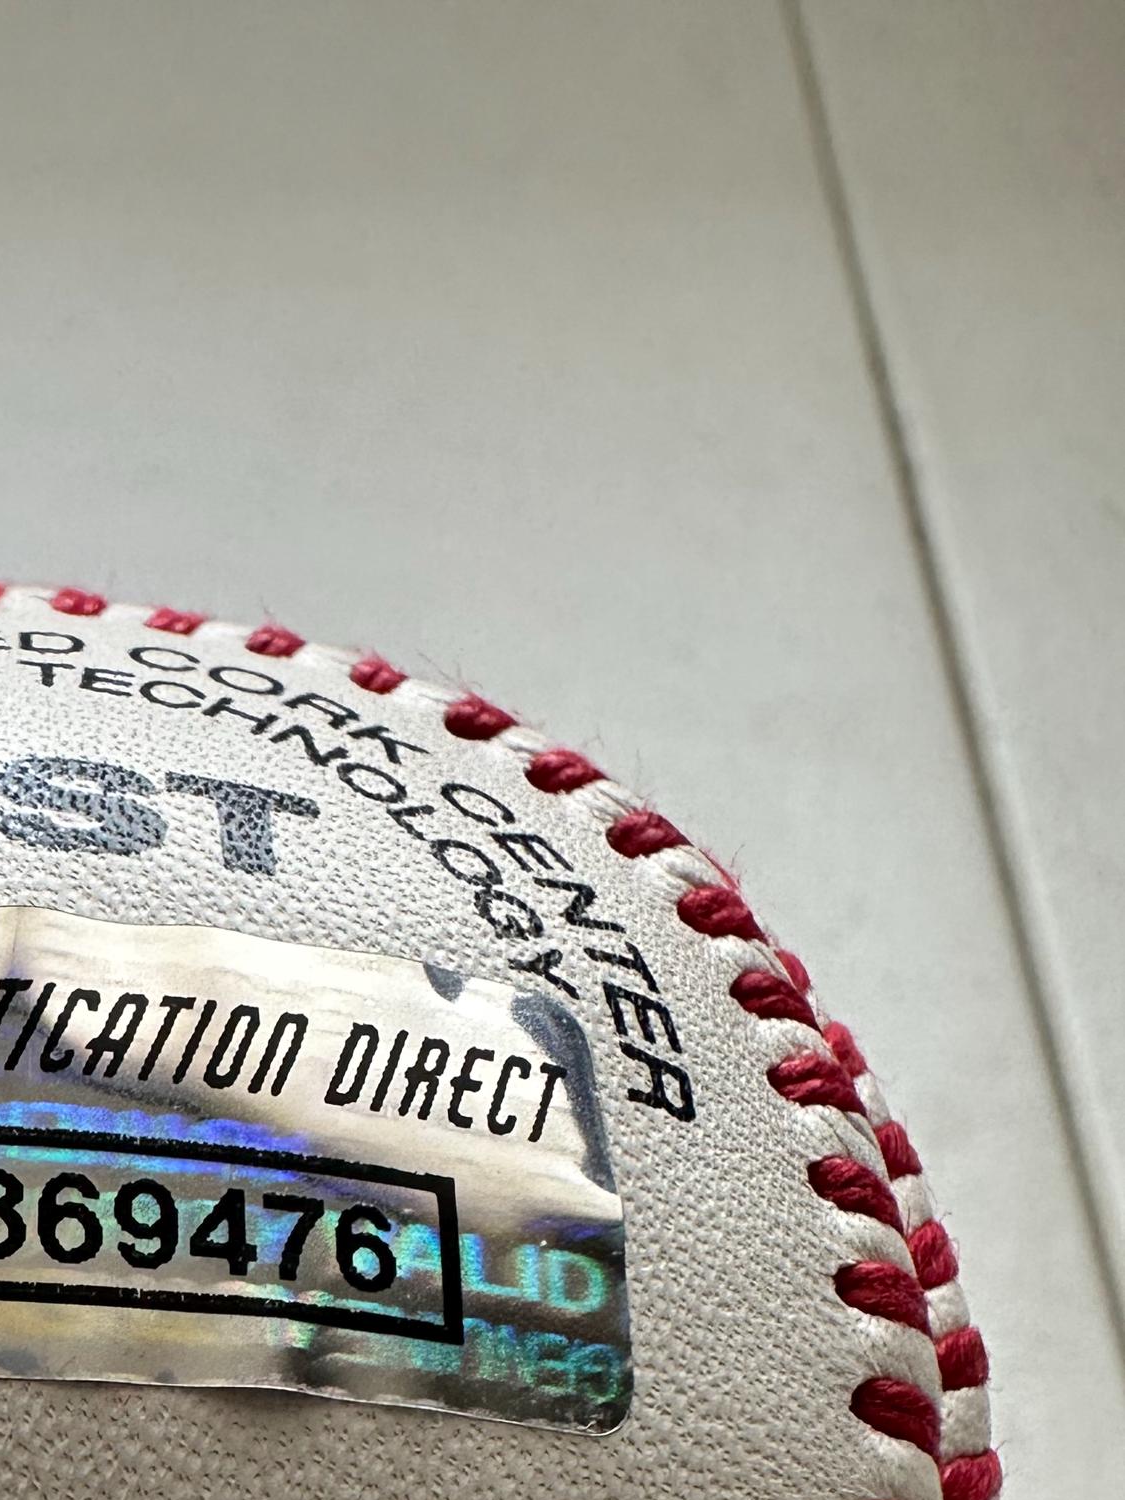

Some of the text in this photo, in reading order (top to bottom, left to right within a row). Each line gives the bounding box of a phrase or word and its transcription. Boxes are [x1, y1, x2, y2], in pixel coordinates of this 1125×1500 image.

[17, 659, 580, 1000] TECHNOLOGY
[128, 646, 429, 765] CORK
[441, 782, 696, 1122] CENTER
[323, 1021, 568, 1142] DIRECT
